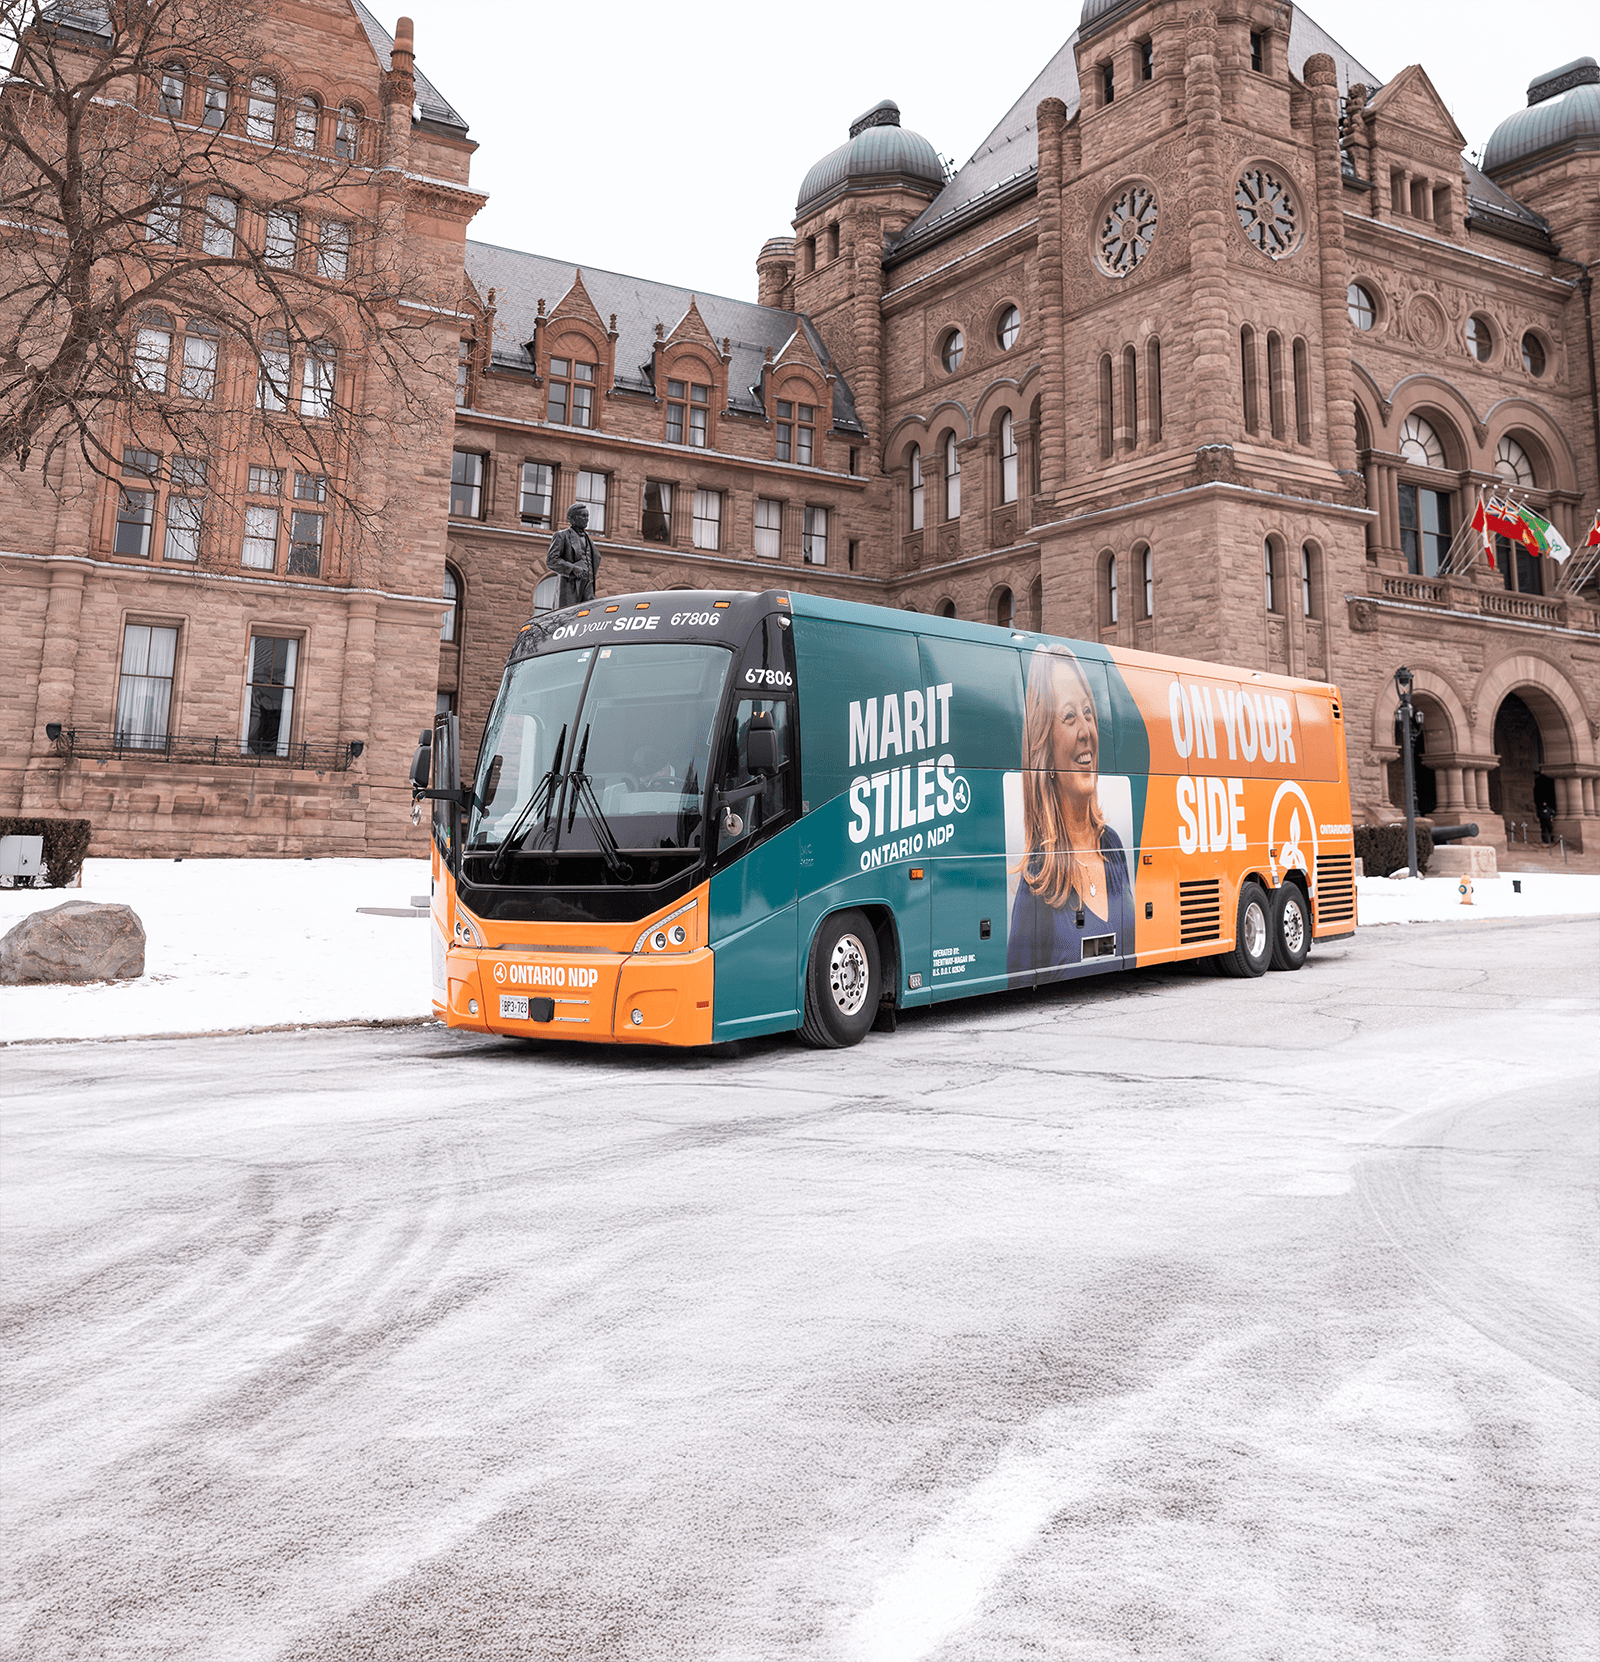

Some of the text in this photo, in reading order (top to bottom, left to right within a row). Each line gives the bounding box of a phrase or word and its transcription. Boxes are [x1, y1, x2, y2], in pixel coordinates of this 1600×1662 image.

[552, 616, 661, 641] ON your SIDE
[670, 612, 721, 626] 67806
[745, 668, 793, 686] 67806
[848, 682, 954, 768] MARIT
[1168, 680, 1297, 764] ON YOUR
[848, 753, 955, 844] STILES
[1176, 775, 1248, 855] SIDE
[860, 823, 955, 871] ONTARIO NDP
[933, 948, 953, 957] OPERATED
[509, 964, 598, 988] ONTARIO NDP
